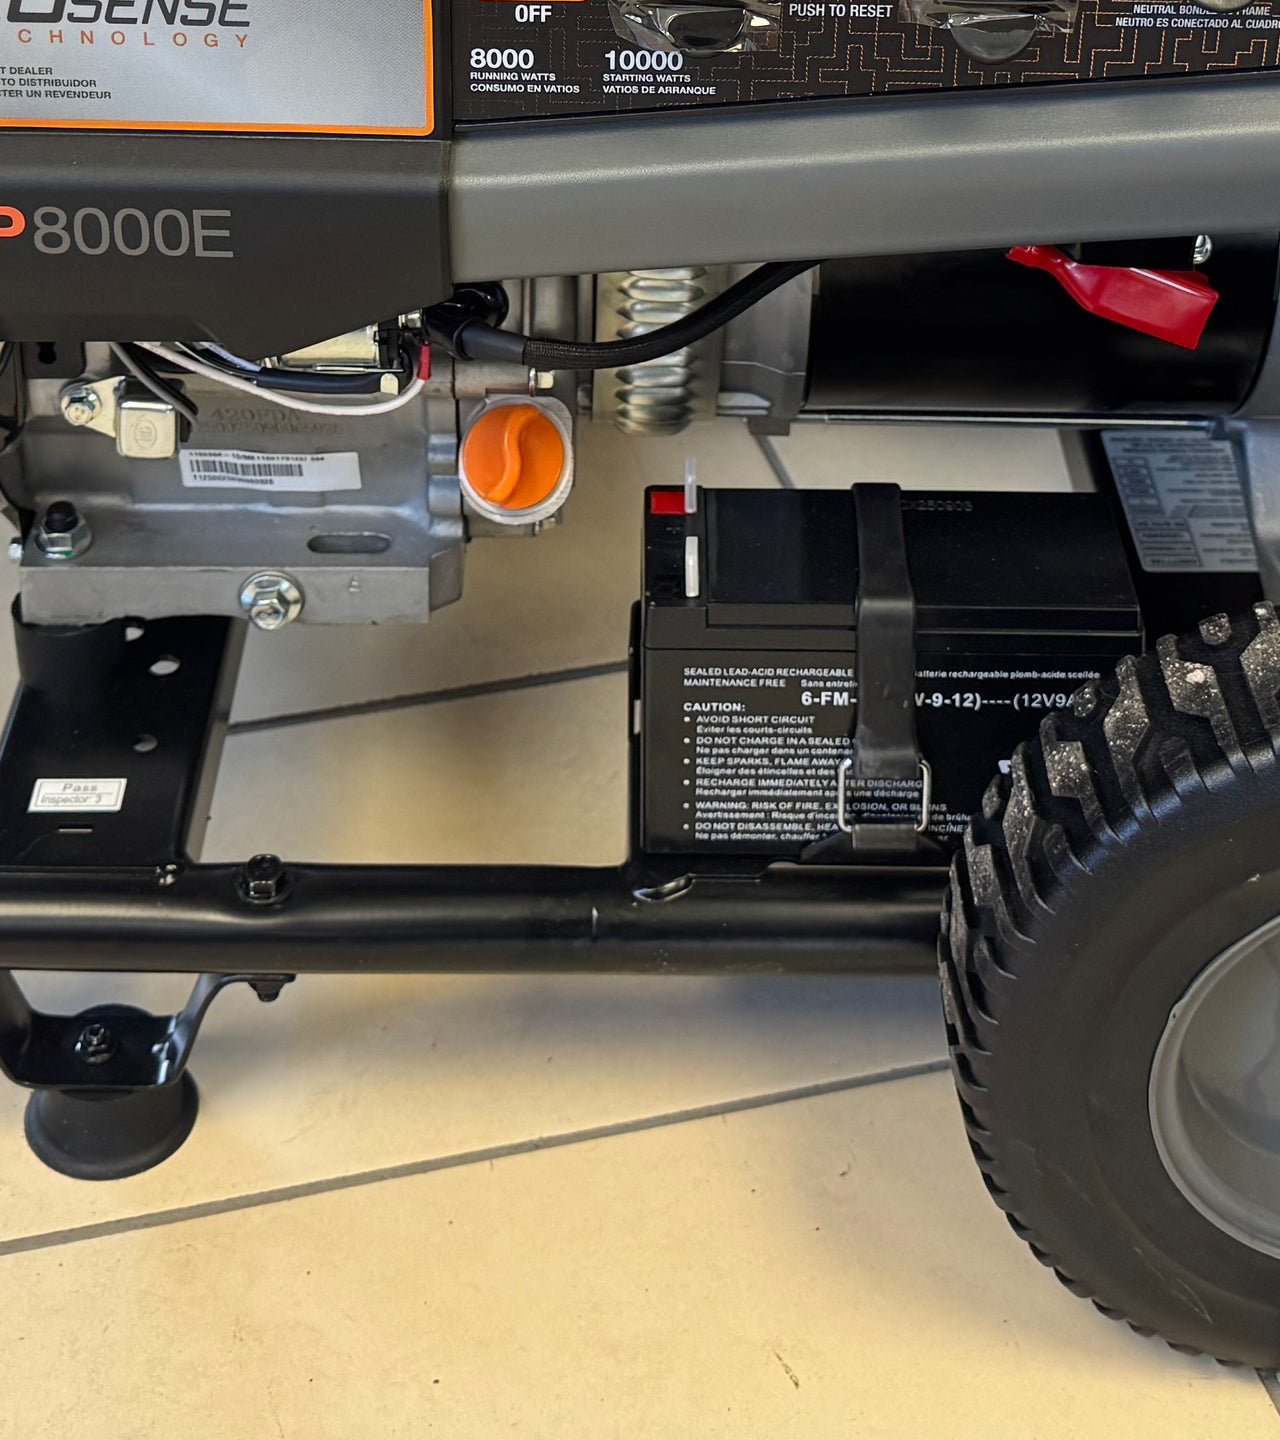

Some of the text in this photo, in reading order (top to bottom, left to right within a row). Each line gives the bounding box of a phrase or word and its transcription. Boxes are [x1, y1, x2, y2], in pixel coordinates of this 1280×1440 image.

[514, 4, 552, 23] OFF
[789, 3, 893, 18] PUSH TO RESET
[1133, 4, 1176, 15] NEUTRAL
[1179, 5, 1218, 15] BON
[1115, 17, 1154, 27] NEUTRO
[1156, 17, 1169, 27] ES
[1171, 17, 1229, 28] CONECTADO
[1231, 18, 1243, 28] AL
[470, 48, 535, 70] 8000
[604, 49, 683, 71] 10000
[9, 66, 53, 75] DEALER
[470, 72, 556, 81] RUNNING WATTS
[602, 73, 691, 83] STARTING WATTS
[18, 78, 97, 88] DISTRIBUIDOR
[470, 83, 580, 94] CONSUMO EN VATIOS
[602, 85, 716, 96] VATIOS DE ARRANQUE
[26, 89, 43, 98] UN
[44, 89, 112, 100] REVENDEUR
[683, 667, 854, 677] SEALED LEAD-ACID RECHARGEABLE
[914, 670, 947, 679] atterie
[948, 670, 1009, 680] rechargeable
[683, 678, 824, 688] MAINTENANCE FREE Sans
[683, 702, 745, 712] CAUTION:
[696, 715, 816, 724] AVOID SHORT CIRCUIT
[696, 736, 713, 745] DO
[714, 736, 737, 745] NOT
[738, 736, 784, 745] CHARGE
[808, 737, 851, 745] SEALED
[712, 747, 730, 755] pas
[731, 746, 769, 756] charger
[771, 747, 795, 755] dans
[696, 757, 725, 765] KEEP
[774, 757, 810, 766] FLAME
[811, 758, 841, 766] AWAY
[738, 767, 756, 775] des
[62, 783, 98, 792] Pass
[695, 778, 923, 788] RECHARGE IMMEDIATELY ATER DISCHARG
[751, 802, 777, 810] RISK
[778, 802, 794, 810] OF
[891, 803, 908, 811] OR
[695, 822, 712, 830] DO
[713, 822, 736, 830] NOT
[817, 823, 840, 831] HEA
